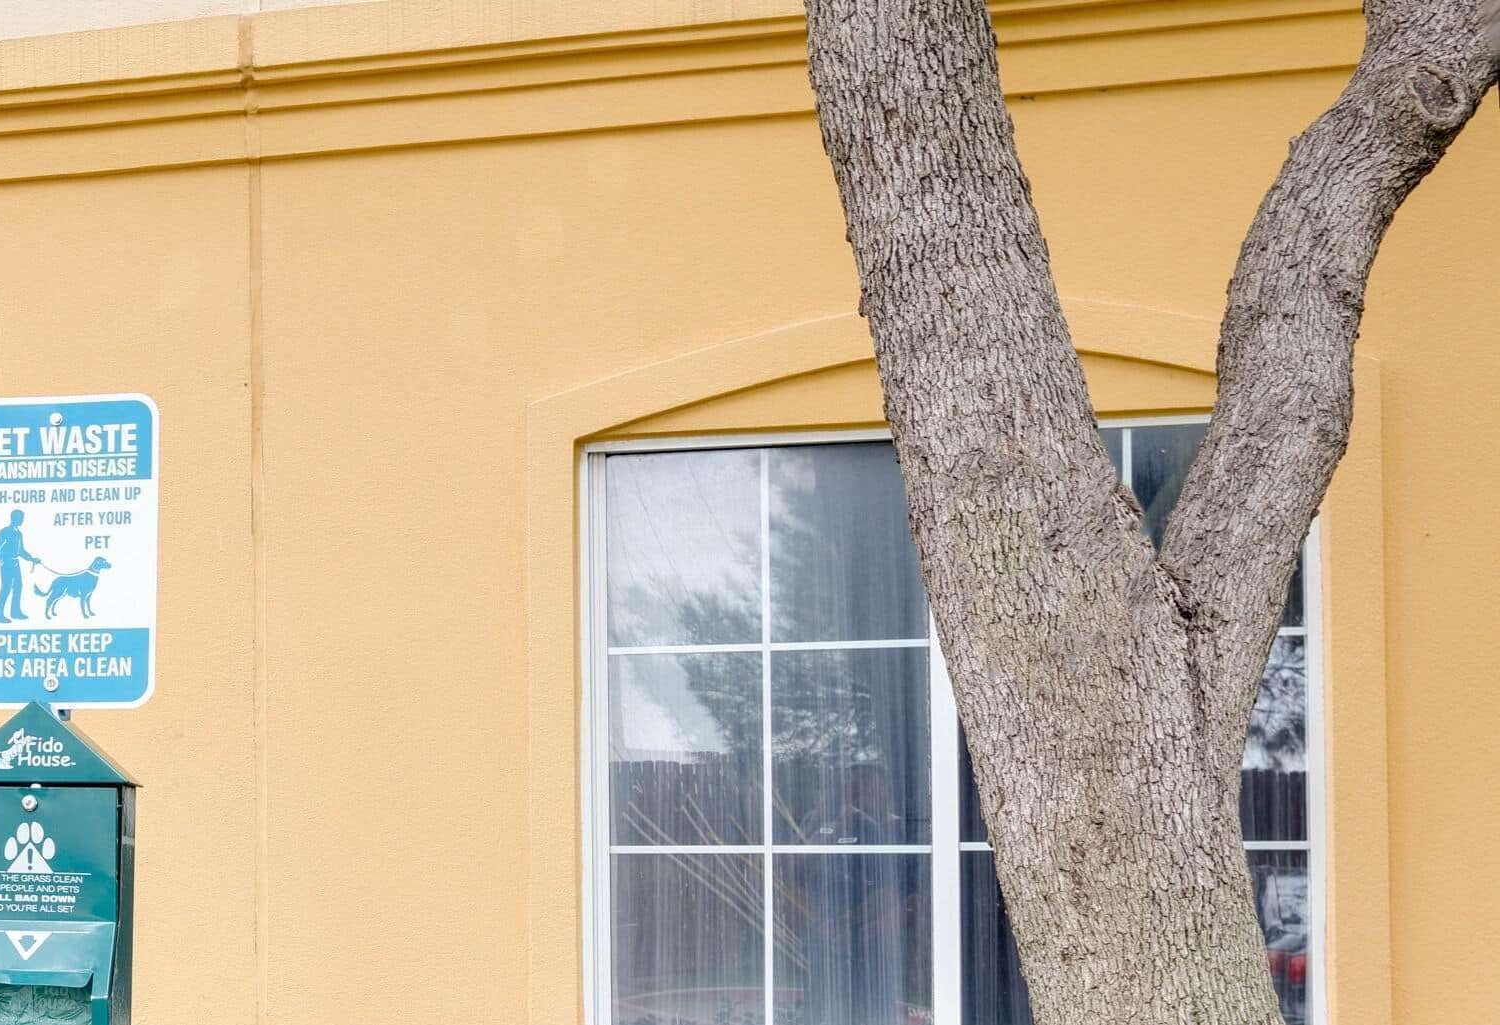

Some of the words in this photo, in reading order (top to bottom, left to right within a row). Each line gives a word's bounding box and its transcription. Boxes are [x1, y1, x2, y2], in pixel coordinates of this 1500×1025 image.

[39, 423, 138, 455] WASTE
[71, 458, 137, 478] DISEASE
[50, 488, 76, 503] AND
[80, 487, 120, 502] CLEAN
[124, 486, 141, 501] UP
[53, 511, 93, 526] AFTER
[98, 510, 132, 525] YOUR
[84, 535, 111, 549] PET
[68, 632, 113, 653] KEEP
[20, 656, 69, 678] AREA
[74, 656, 132, 677] CLEAN
[25, 735, 64, 753] Fido
[17, 750, 71, 767] House
[2, 874, 19, 882] THE
[20, 874, 50, 883] GRASS
[53, 875, 83, 884] CLEAN
[0, 884, 34, 892] PEOPLE
[36, 885, 55, 893] AND
[56, 885, 80, 894] PETS
[14, 894, 38, 903] BAG
[41, 895, 76, 903] DOWN
[5, 904, 37, 912] YOU'RE
[39, 904, 56, 913] ALL
[57, 905, 75, 913] SET
